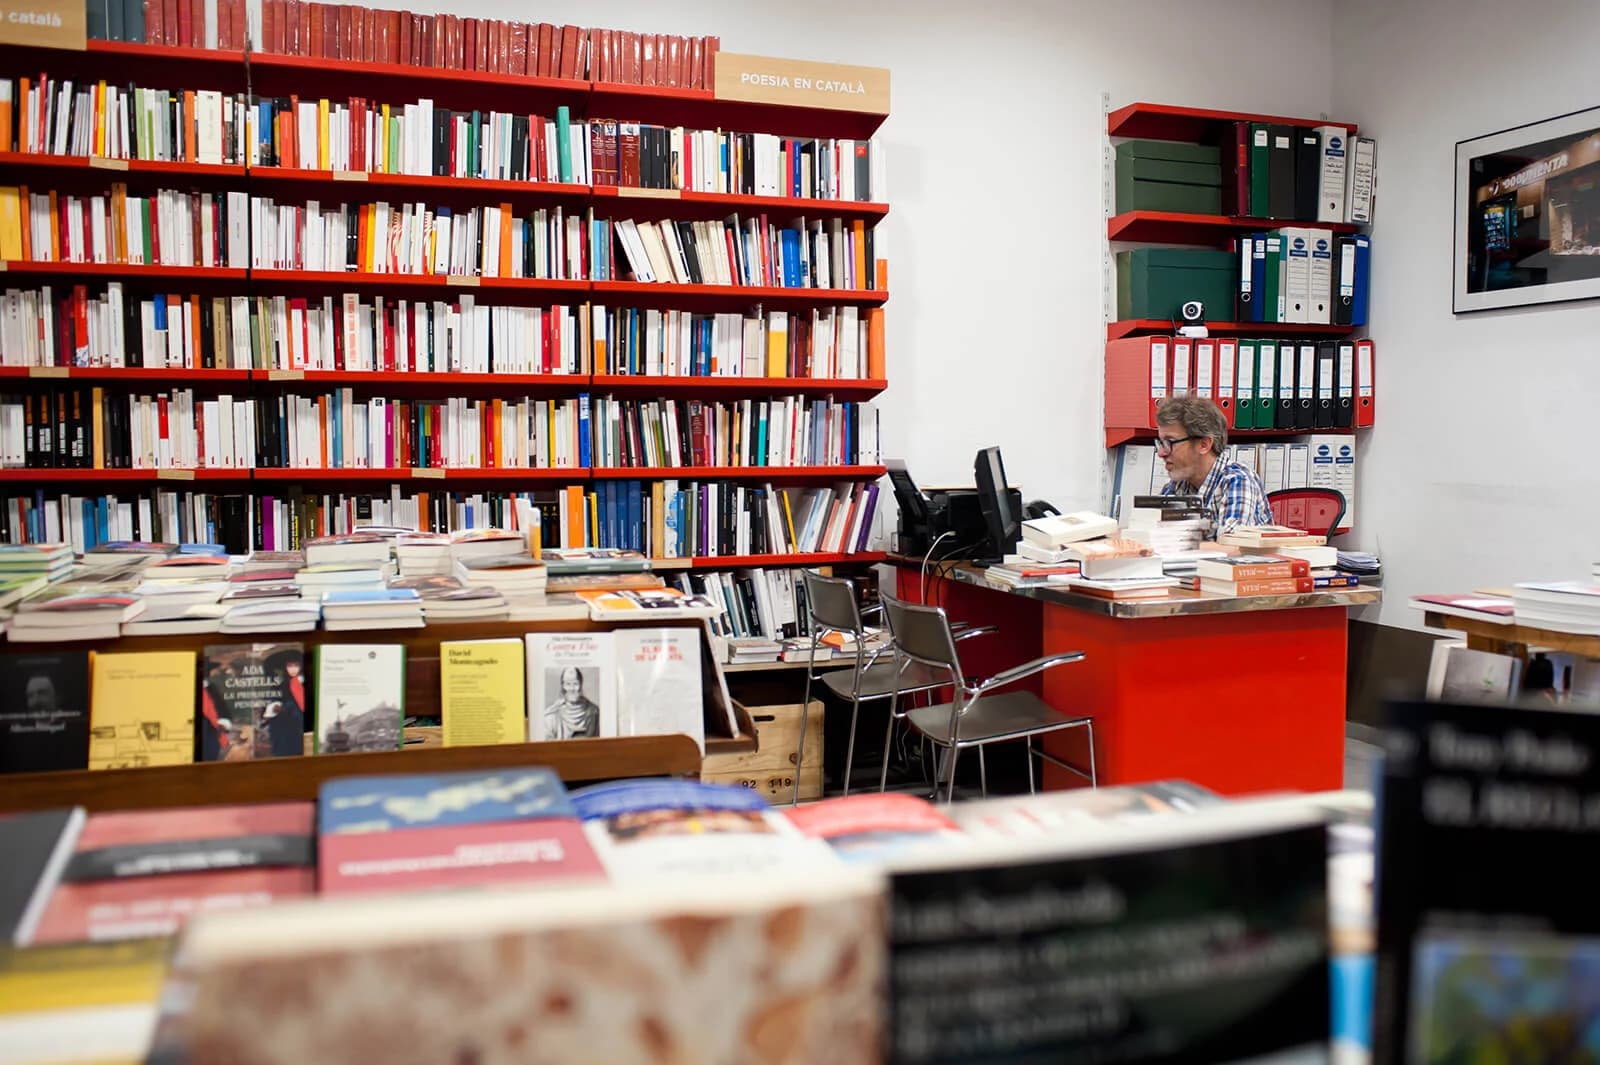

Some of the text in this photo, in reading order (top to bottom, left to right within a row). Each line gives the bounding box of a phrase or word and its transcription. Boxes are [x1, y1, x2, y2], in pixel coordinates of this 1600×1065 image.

[8, 11, 61, 27] català
[741, 73, 865, 94] POESIA EN CATALÀ
[241, 664, 265, 676] ADA
[224, 676, 282, 689] CASTELLS
